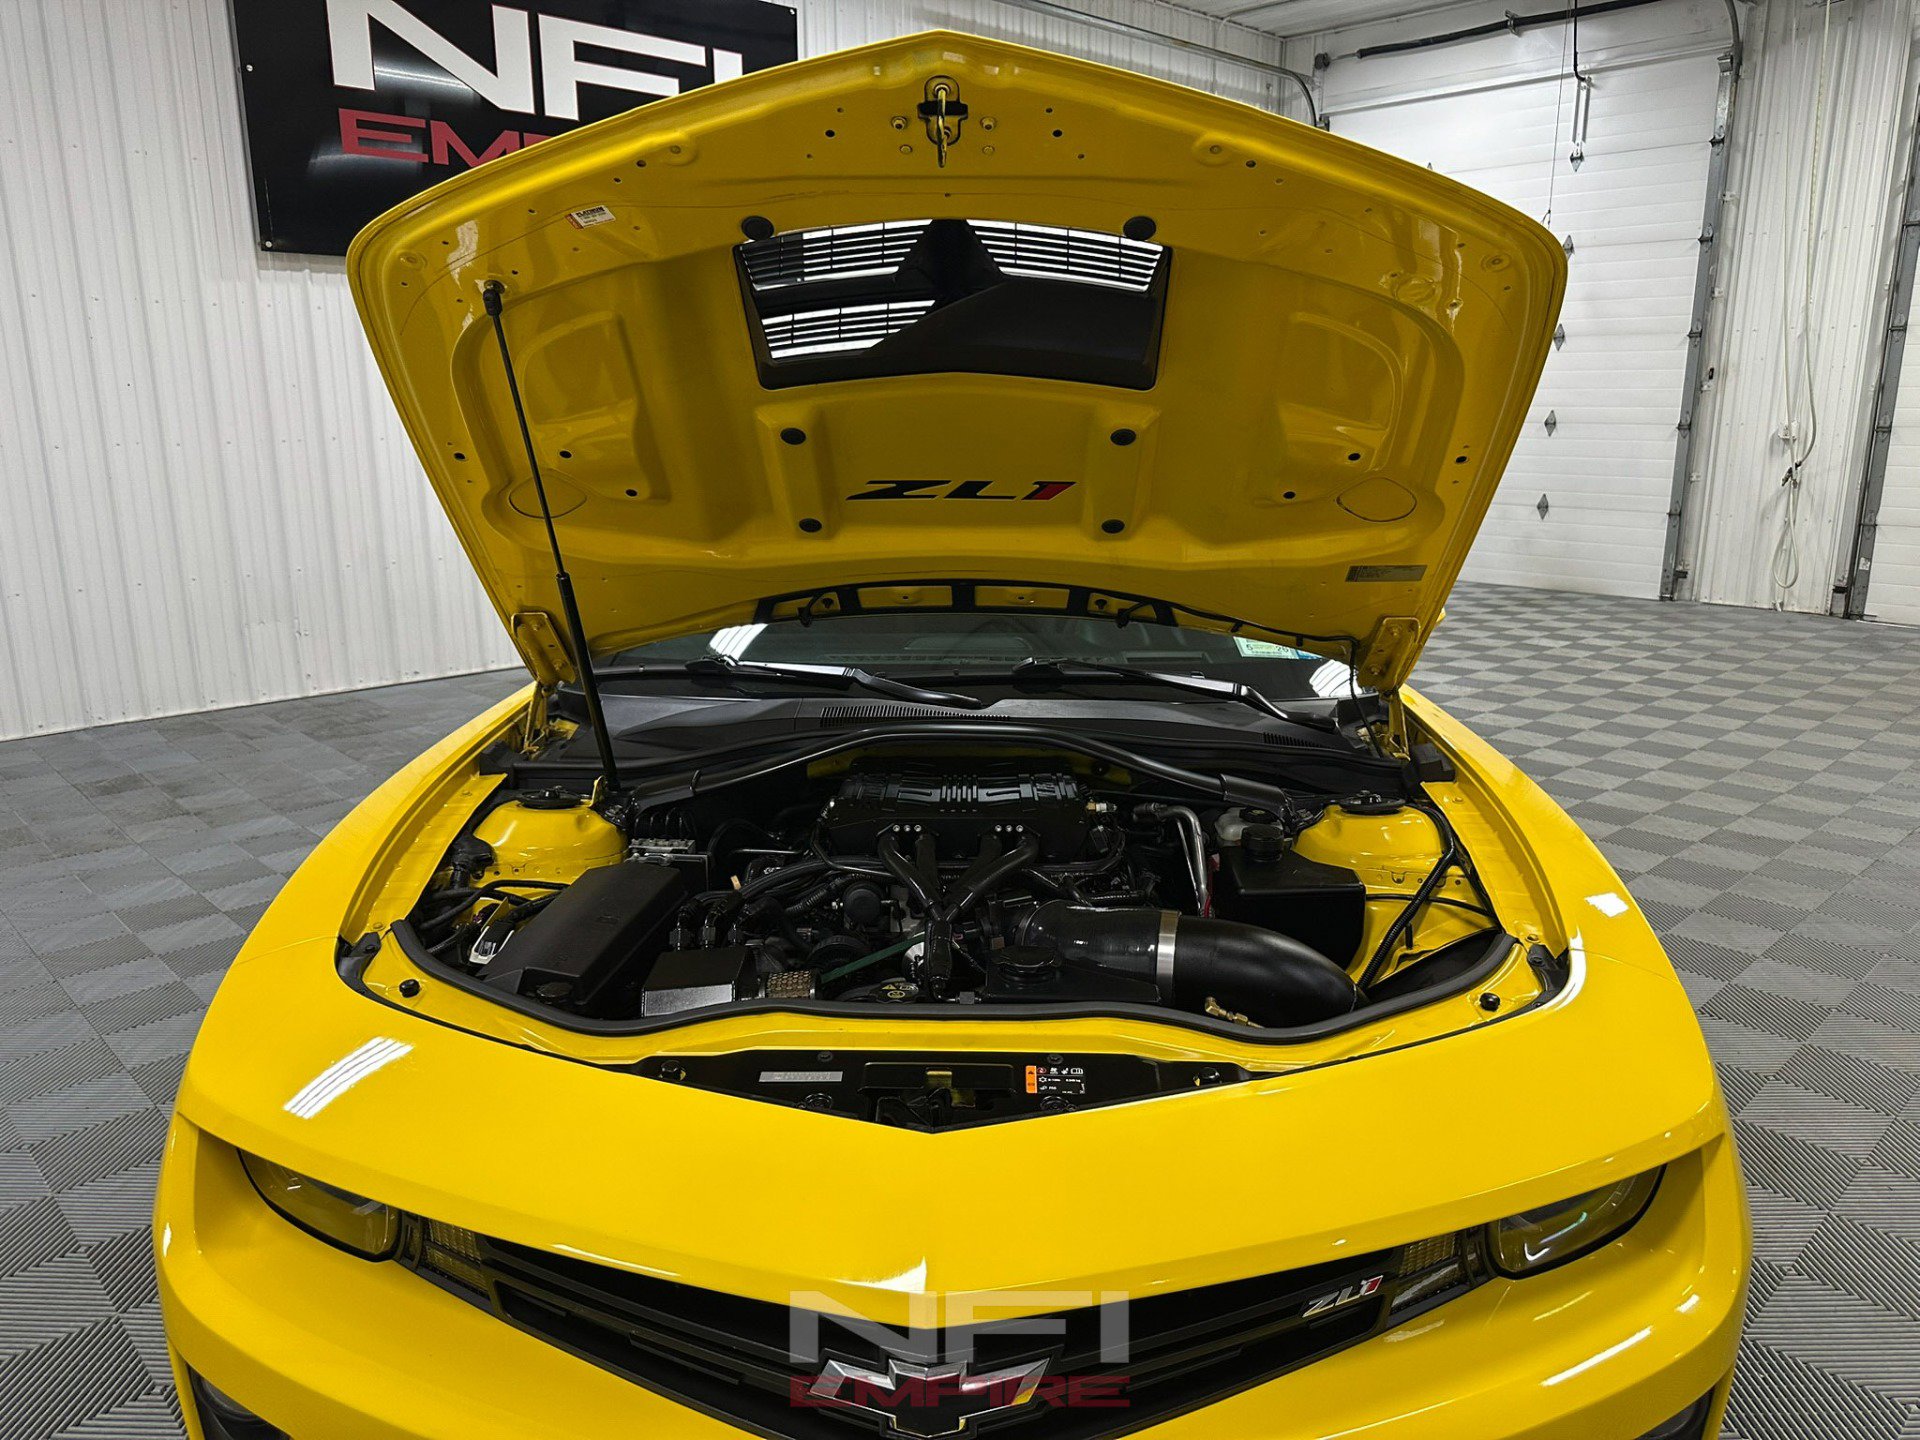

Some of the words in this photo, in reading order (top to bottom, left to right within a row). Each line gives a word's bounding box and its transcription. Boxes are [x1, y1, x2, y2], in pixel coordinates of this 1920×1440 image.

[338, 108, 556, 168] EM
[846, 480, 1077, 501] ZL1
[1302, 1274, 1384, 1317] ZL1
